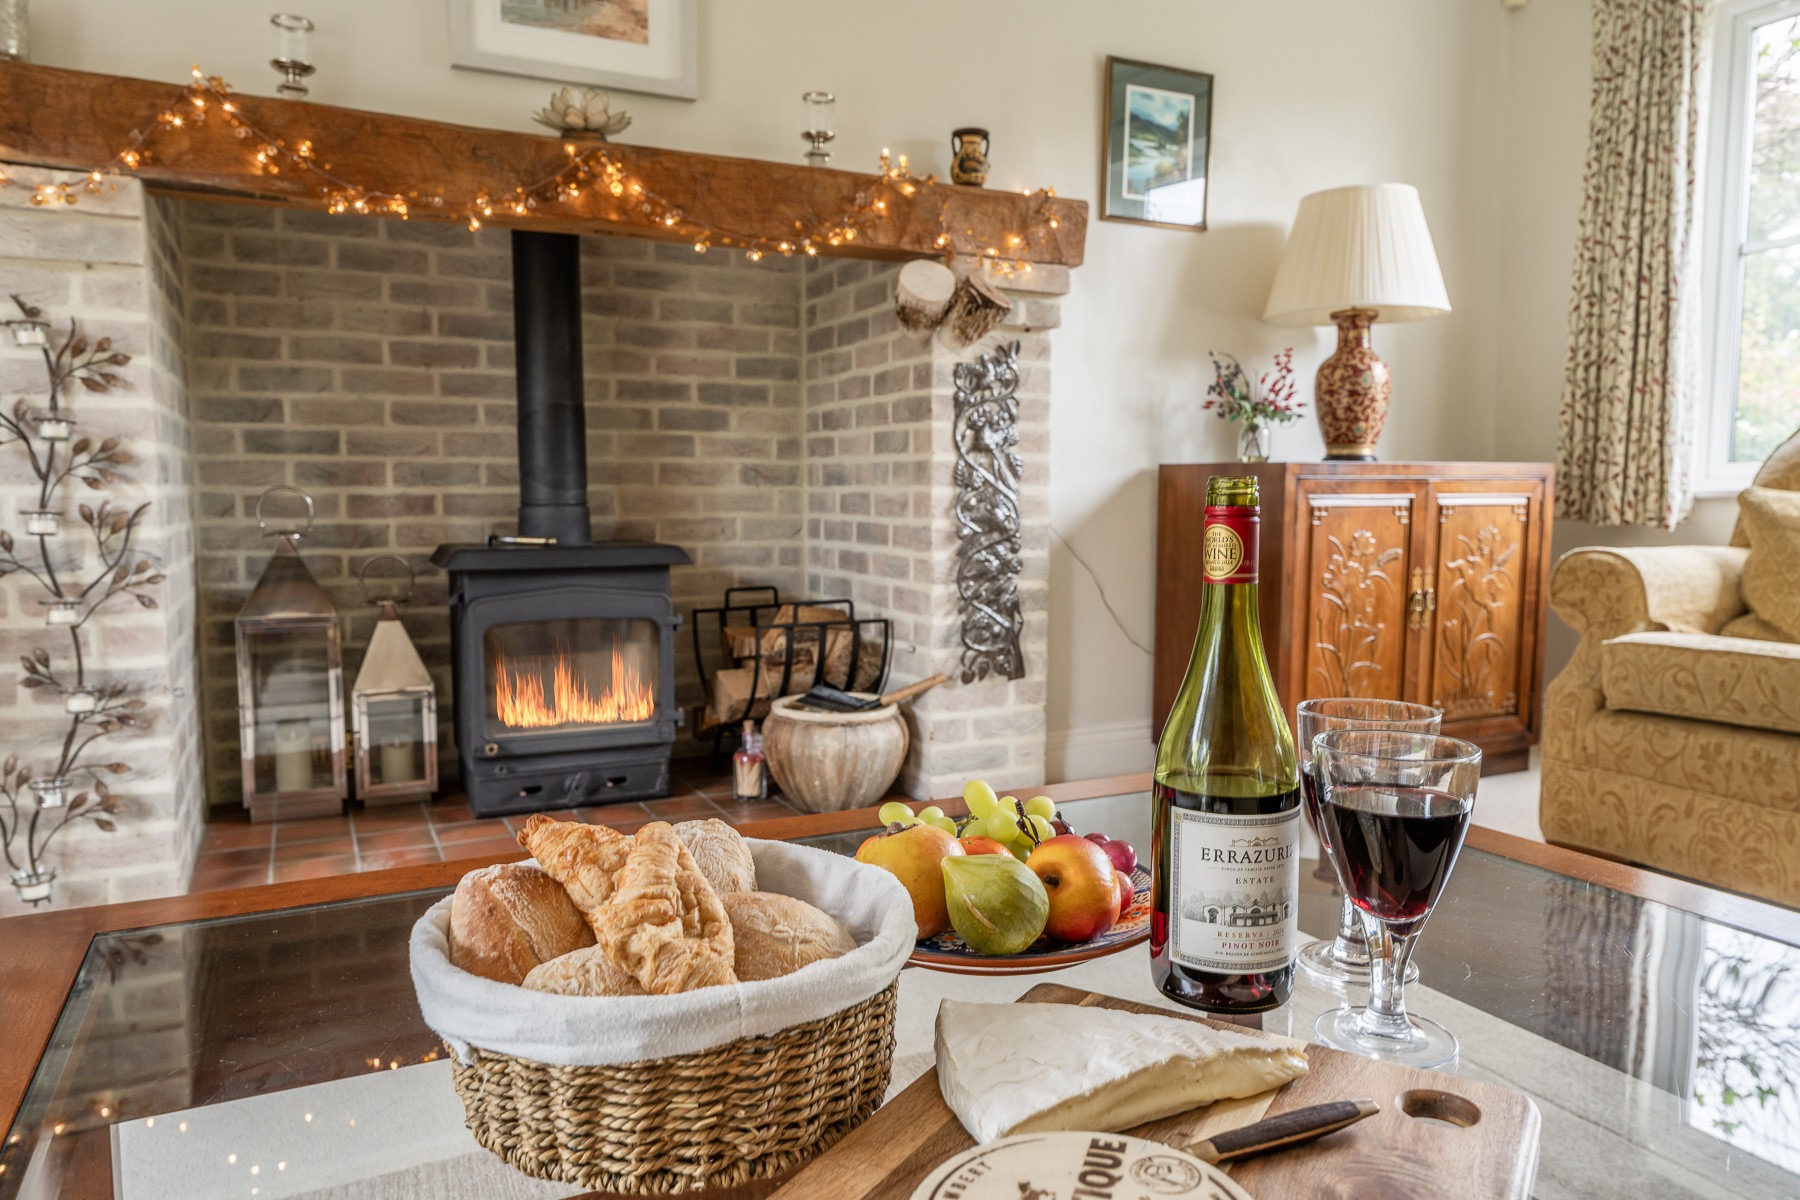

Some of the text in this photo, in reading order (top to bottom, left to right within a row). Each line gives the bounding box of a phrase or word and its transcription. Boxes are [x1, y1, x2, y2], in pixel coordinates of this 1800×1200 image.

[1205, 548, 1236, 559] WINE
[1235, 875, 1275, 885] ESTATE
[1258, 939, 1280, 949] NOIR
[1071, 1138, 1128, 1200] IQUE
